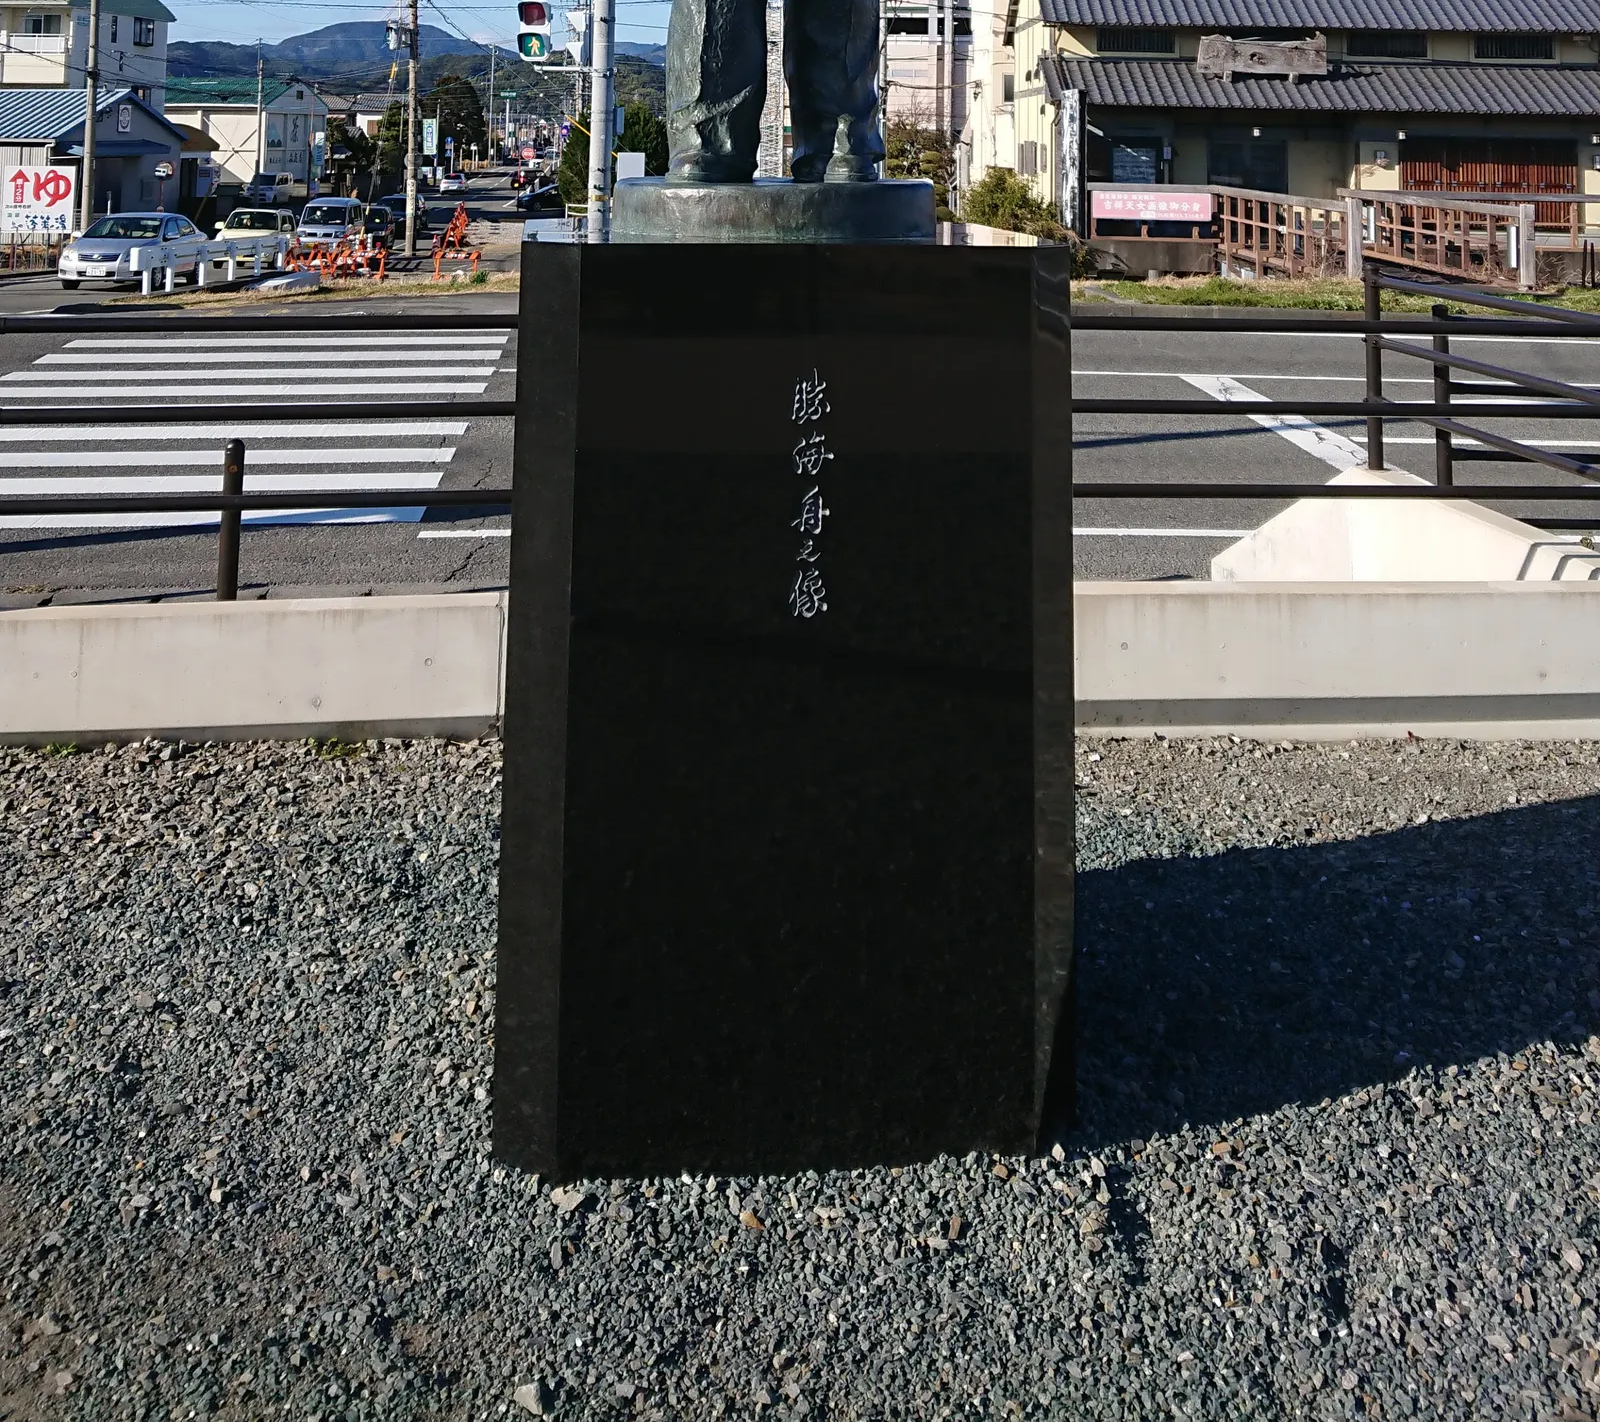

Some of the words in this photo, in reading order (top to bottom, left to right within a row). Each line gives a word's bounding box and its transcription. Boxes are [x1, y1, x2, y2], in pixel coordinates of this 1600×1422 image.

[33, 169, 72, 207] ゆ
[788, 367, 835, 618] 勝海舟之像
